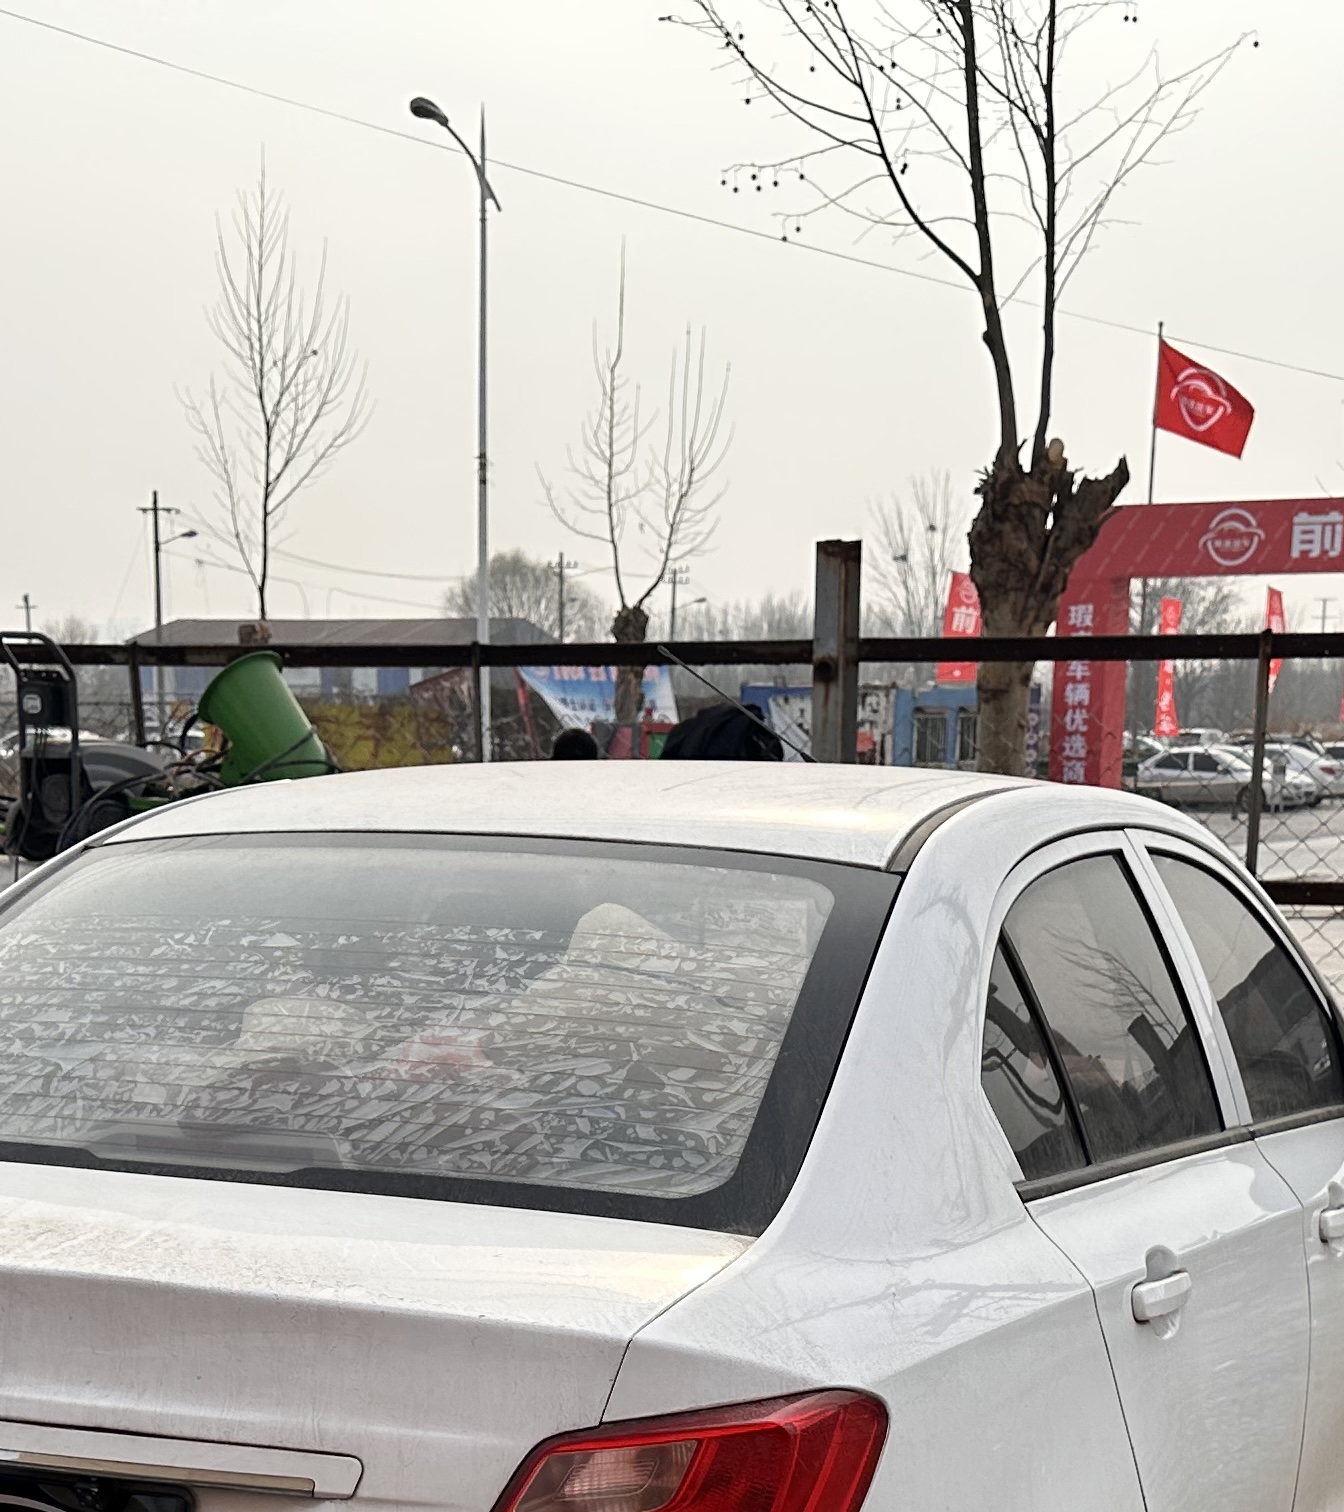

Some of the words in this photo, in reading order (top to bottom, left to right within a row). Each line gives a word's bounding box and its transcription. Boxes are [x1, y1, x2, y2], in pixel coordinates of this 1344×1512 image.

[1062, 603, 1095, 785] 瑕车辆优选商
